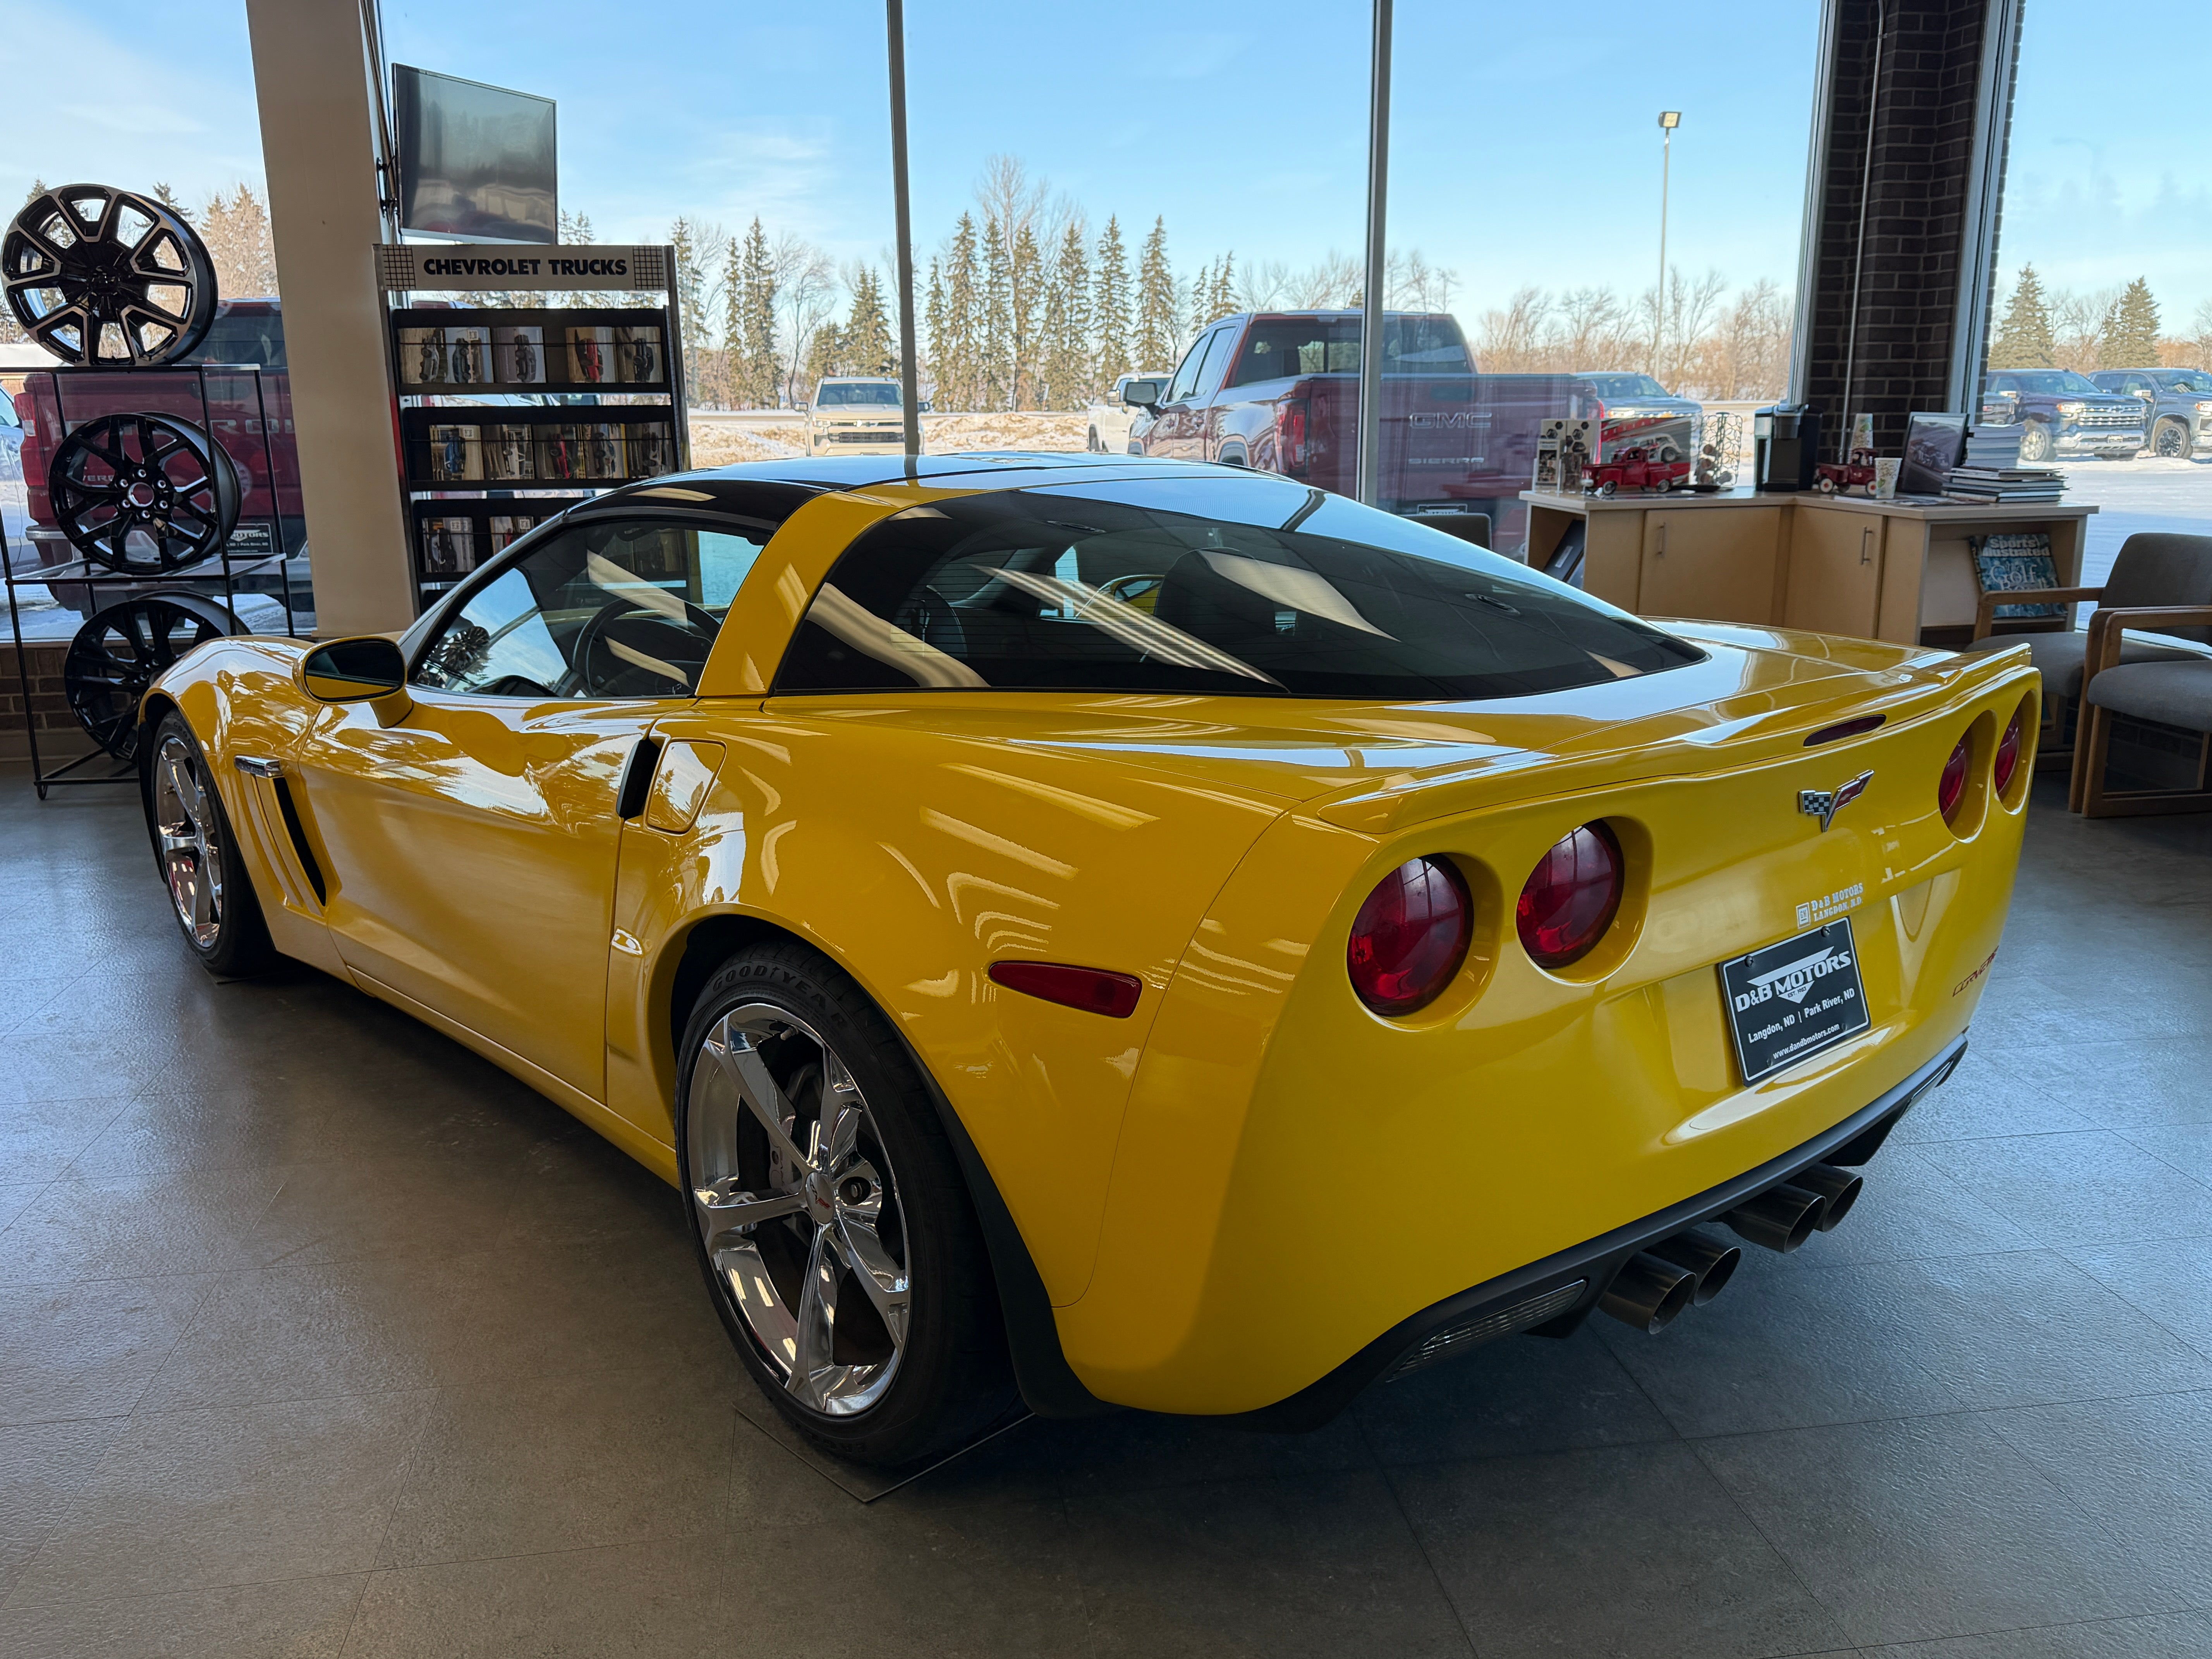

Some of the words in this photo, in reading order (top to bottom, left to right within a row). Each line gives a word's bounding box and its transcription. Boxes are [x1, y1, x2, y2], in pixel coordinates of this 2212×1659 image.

[423, 259, 541, 275] CHEVROLET
[548, 259, 627, 276] TRUCKS
[1409, 412, 1492, 429] GMC
[1982, 546, 2051, 556] Illustrated
[1990, 538, 2037, 549] Sports
[1990, 564, 2037, 585] Golf
[1832, 883, 1863, 903] MOTORS
[1735, 984, 1773, 1012] D&B
[1774, 950, 1851, 995] MOTORS
[713, 965, 849, 1029] GOODYEAR
[1748, 1022, 1783, 1043] Langdon,
[1783, 1014, 1795, 1027] ND
[1804, 1003, 1822, 1018] Park
[1822, 995, 1844, 1010] River,
[1843, 988, 1855, 1001] ND
[1772, 1023, 1840, 1059] www.dandbmotors.com
